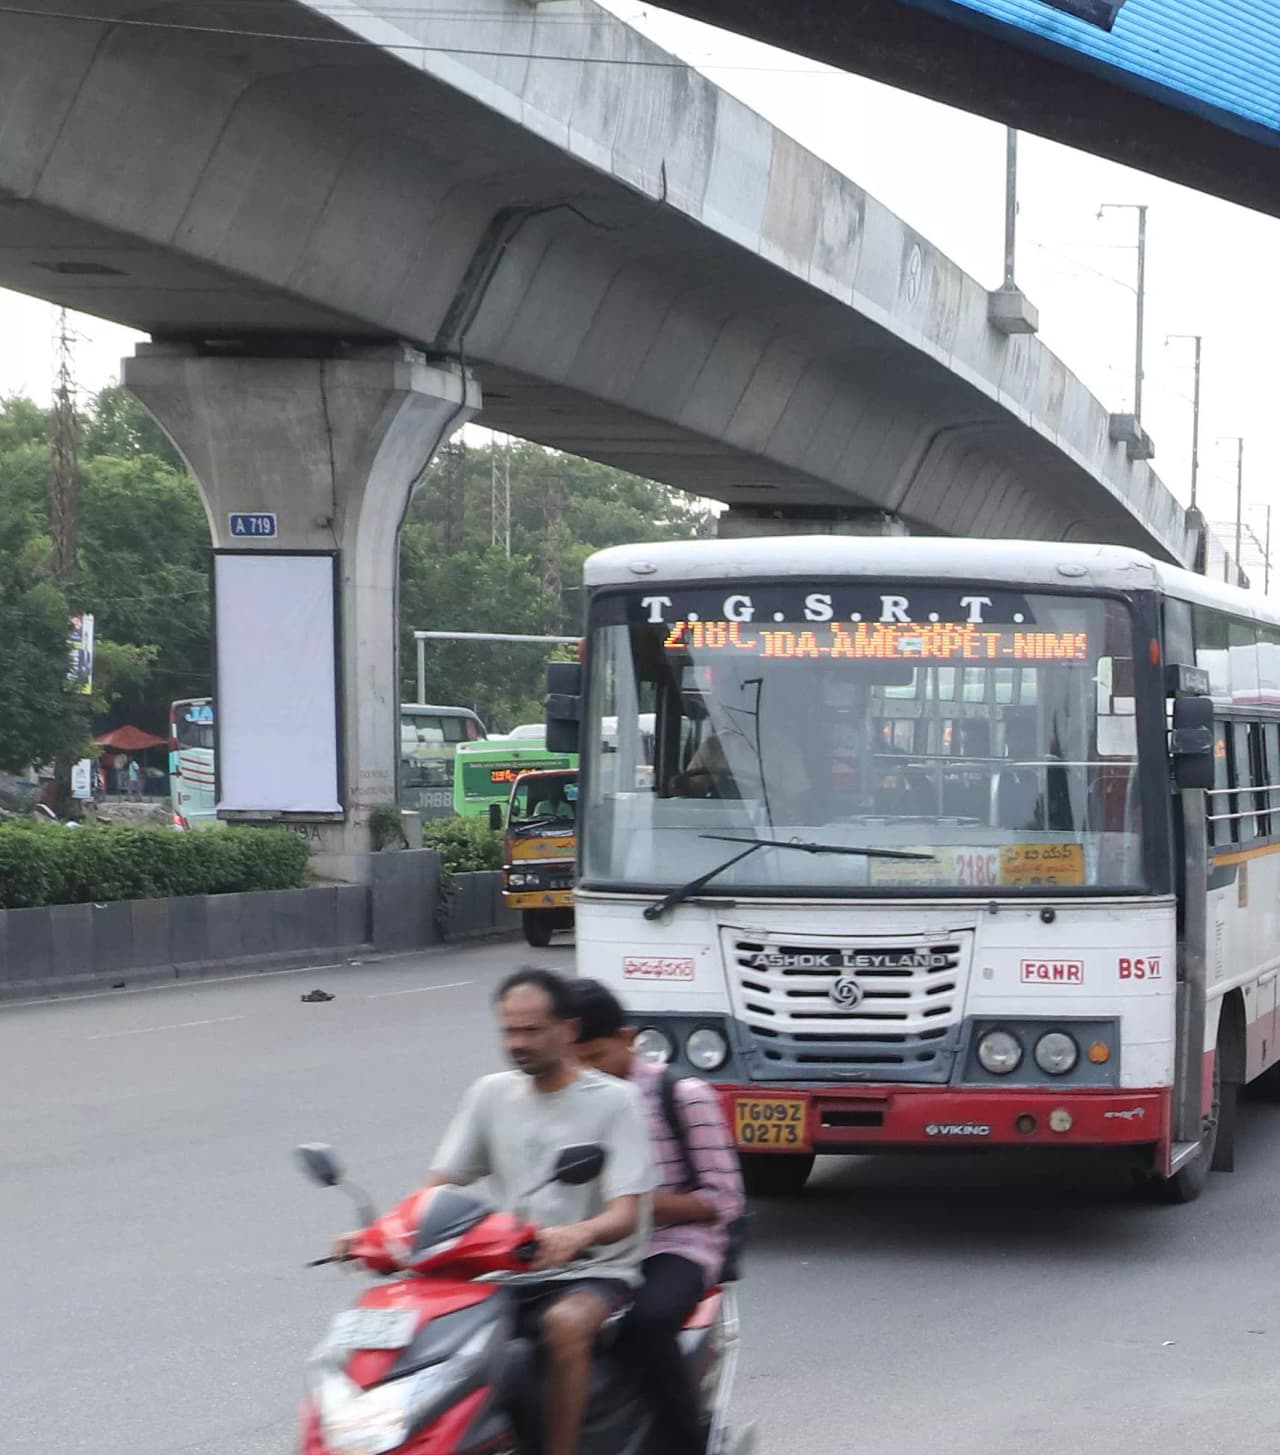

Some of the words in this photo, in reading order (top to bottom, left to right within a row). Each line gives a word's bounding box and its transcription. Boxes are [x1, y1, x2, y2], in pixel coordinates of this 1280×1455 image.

[236, 518, 246, 534] A
[249, 517, 270, 535] 719
[956, 854, 997, 887] 218C
[754, 954, 831, 968] ASHOK
[843, 954, 948, 969] LEYLAND
[1024, 962, 1081, 980] FQNR
[737, 1102, 803, 1123] TG09Z
[742, 1124, 798, 1144] 0273
[939, 1124, 991, 1137] VIKING
